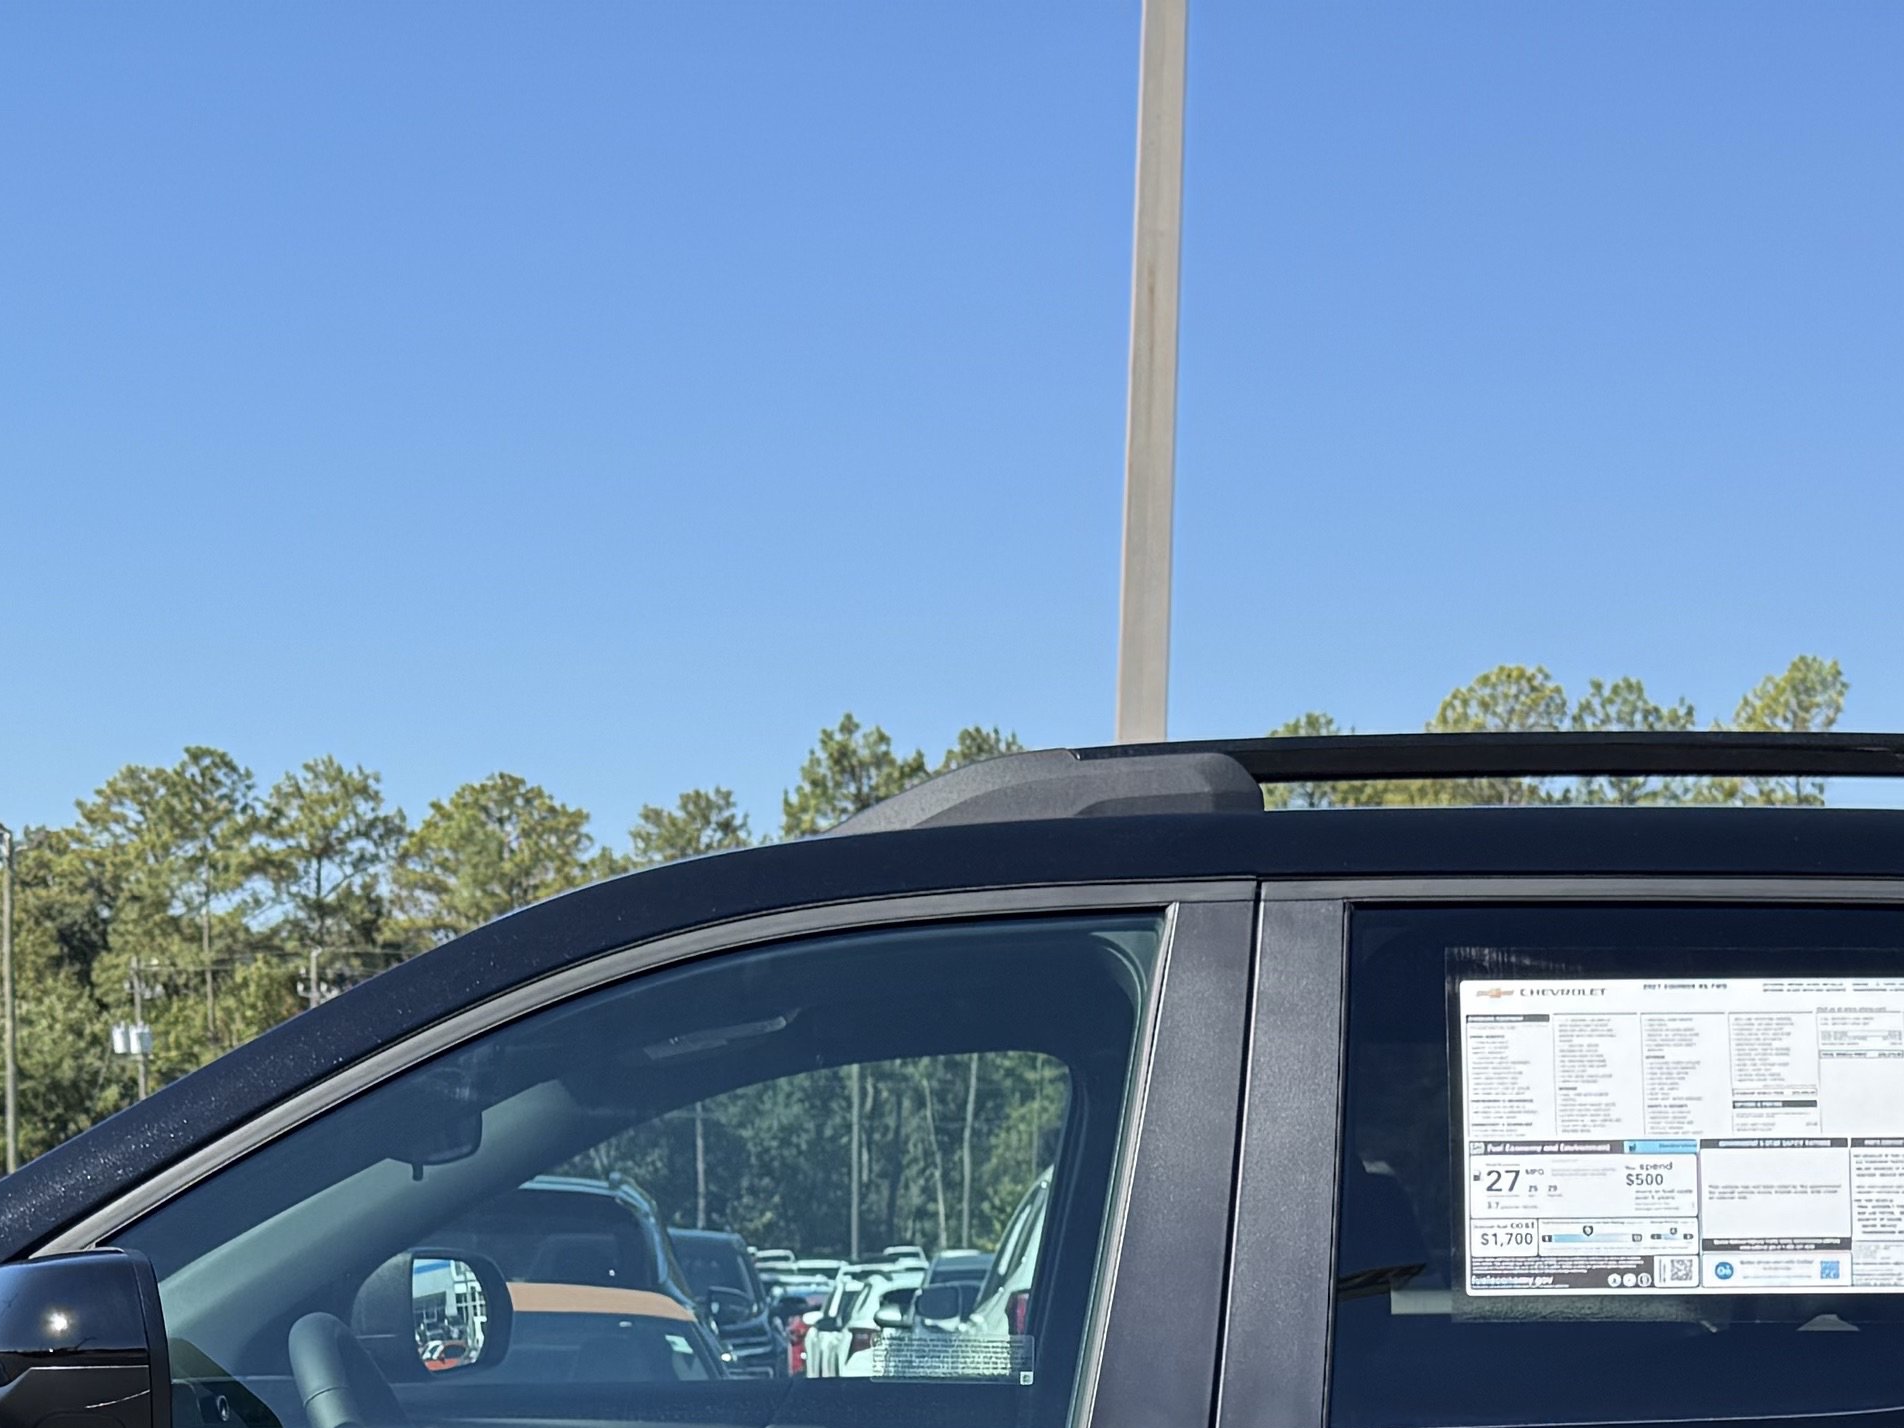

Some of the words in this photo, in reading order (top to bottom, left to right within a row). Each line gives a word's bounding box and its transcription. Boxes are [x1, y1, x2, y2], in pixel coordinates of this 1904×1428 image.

[1520, 987, 1607, 997] CHEVROLET
[1639, 1161, 1673, 1171] spend
[1485, 1169, 1521, 1193] 27
[1625, 1172, 1664, 1187] $500
[1510, 1221, 1535, 1230] cost
[1480, 1232, 1534, 1248] $1,700
